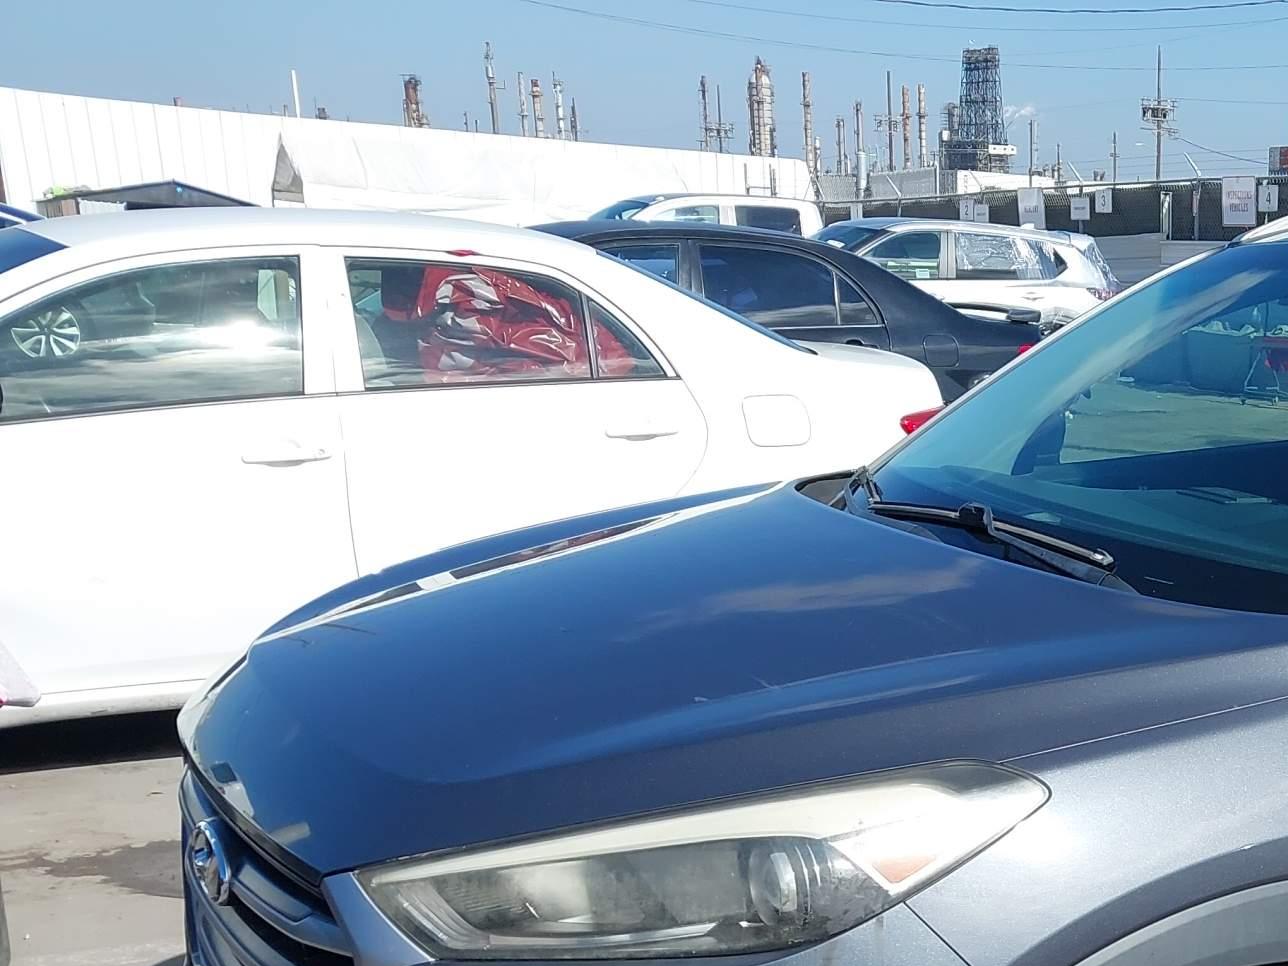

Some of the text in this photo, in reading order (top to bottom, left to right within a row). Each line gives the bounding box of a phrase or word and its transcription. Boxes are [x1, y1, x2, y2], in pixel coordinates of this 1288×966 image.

[1101, 195, 1106, 207] 3
[1265, 191, 1271, 205] 4
[964, 204, 969, 216] 2
